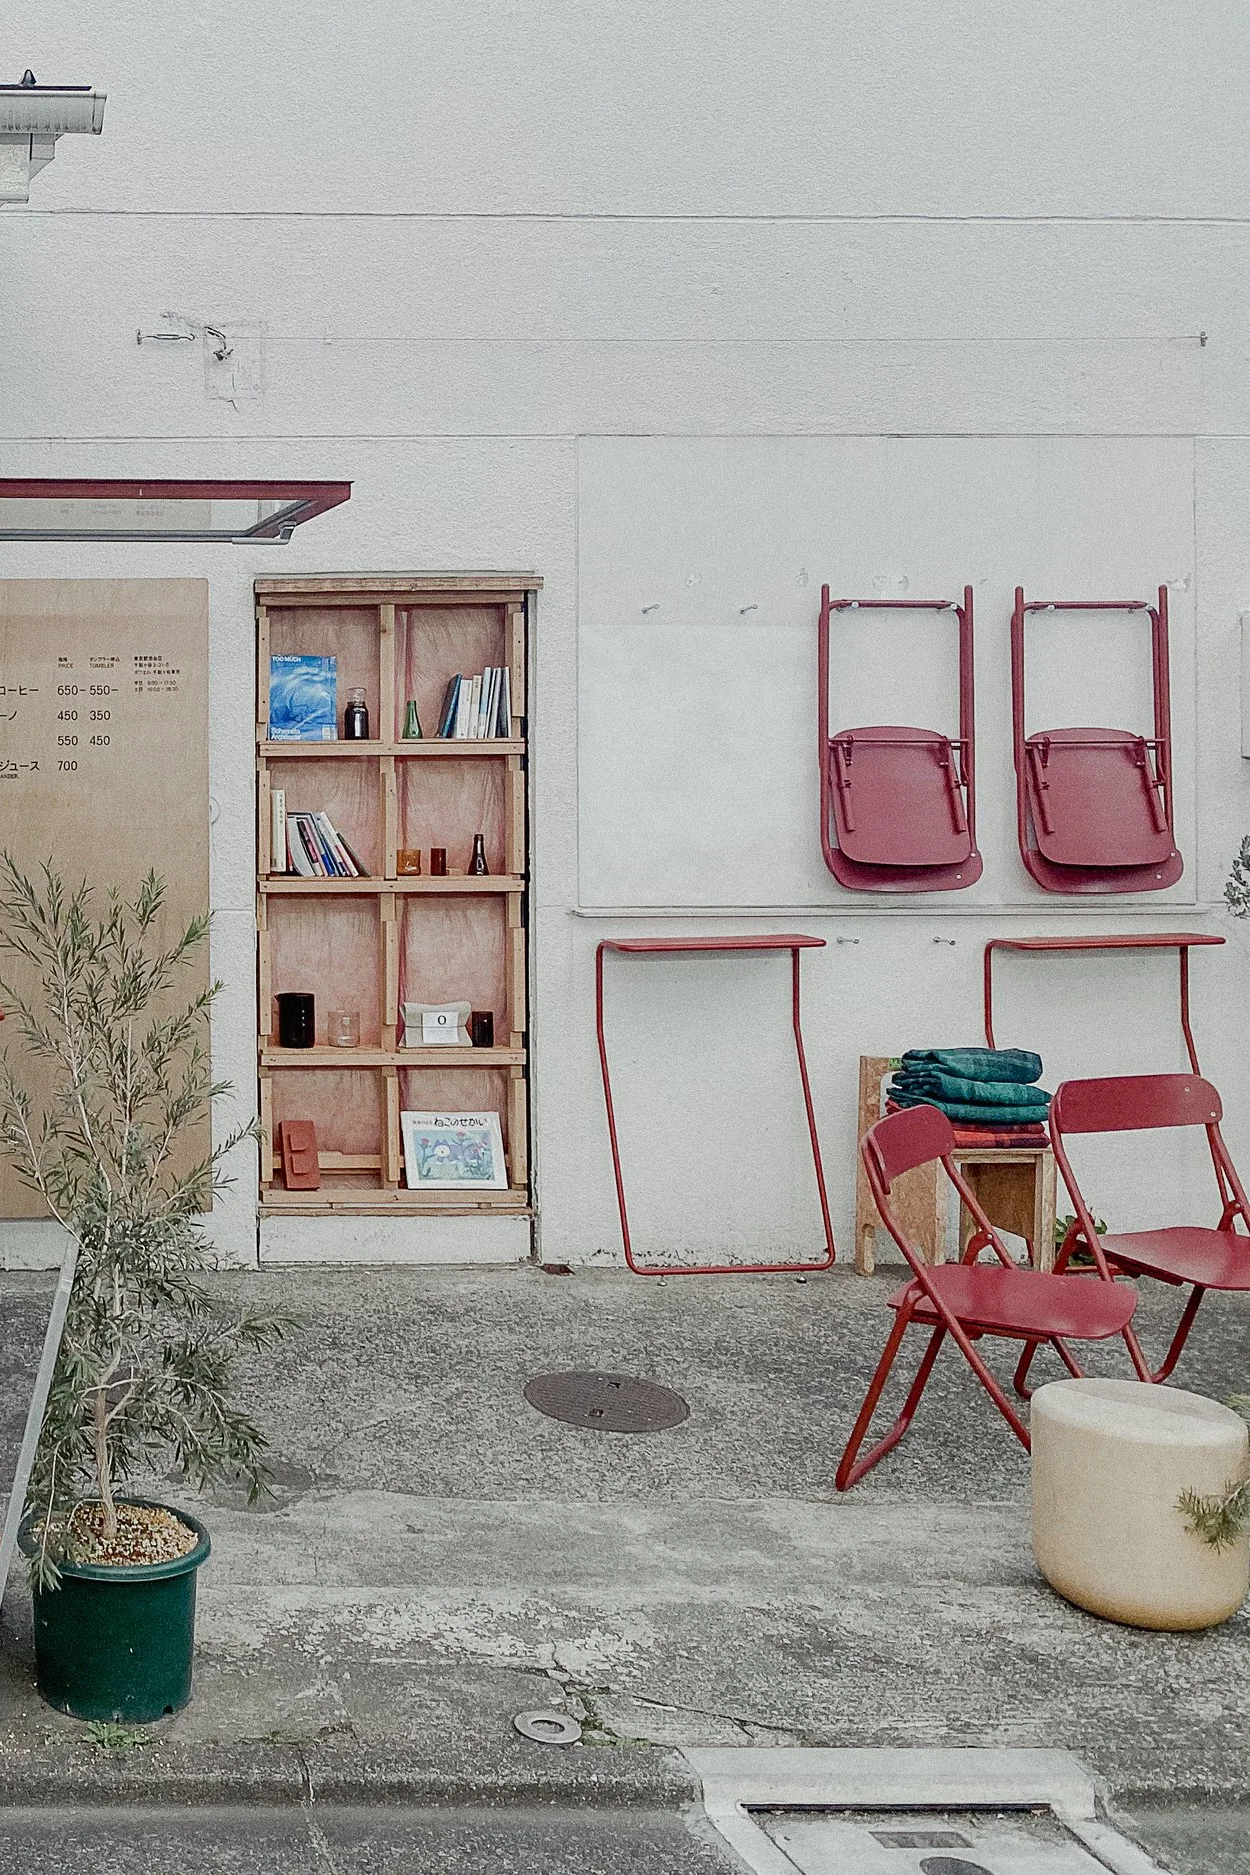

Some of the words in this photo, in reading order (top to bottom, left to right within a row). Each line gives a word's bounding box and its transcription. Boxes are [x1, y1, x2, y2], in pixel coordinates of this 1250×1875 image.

[58, 710, 78, 720] 450
[90, 710, 110, 720] 350
[58, 736, 78, 746] 550
[90, 736, 110, 746] 450
[58, 760, 78, 772] 700
[434, 1116, 487, 1128] ねこのせかい
